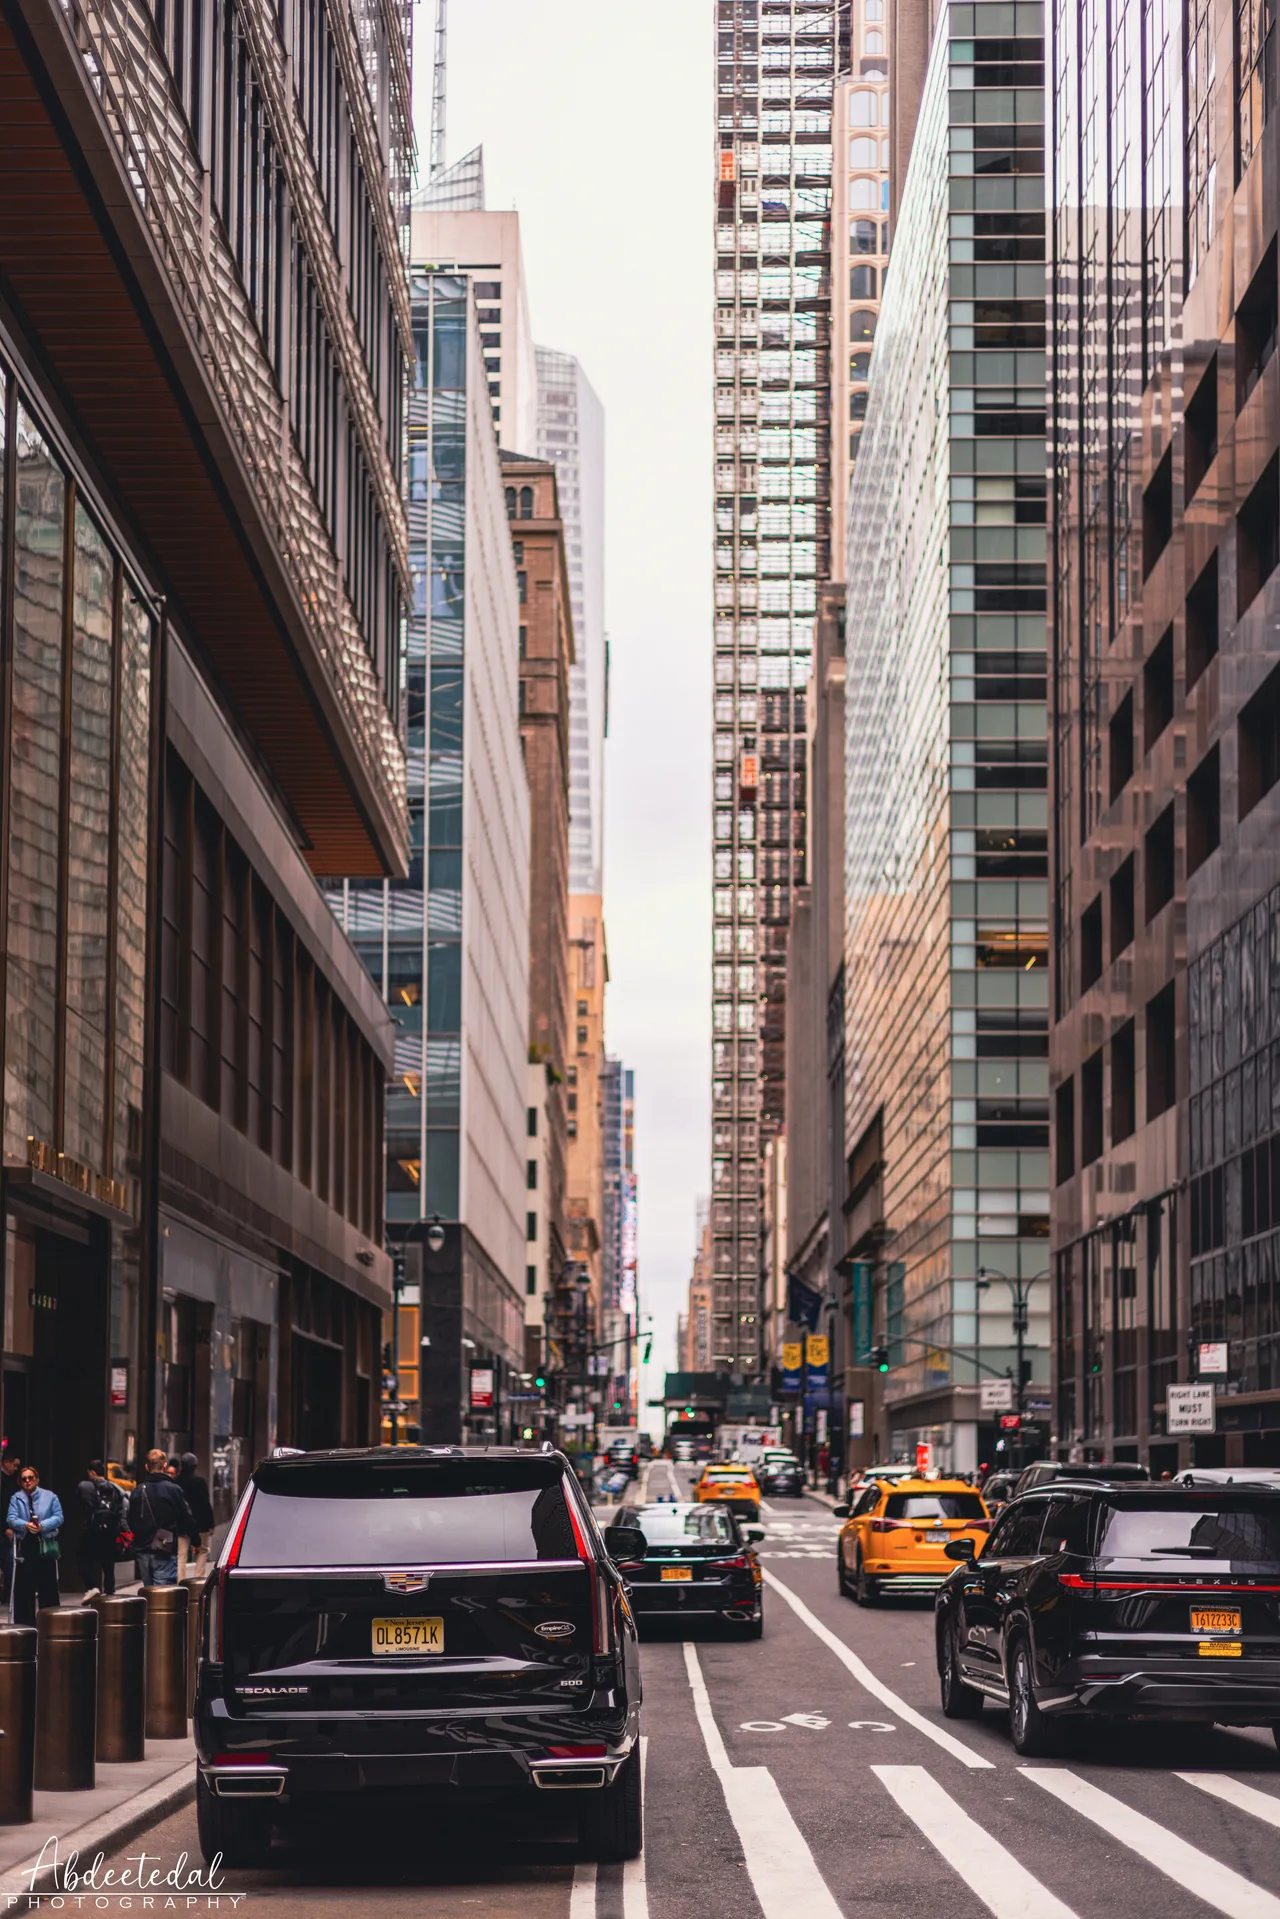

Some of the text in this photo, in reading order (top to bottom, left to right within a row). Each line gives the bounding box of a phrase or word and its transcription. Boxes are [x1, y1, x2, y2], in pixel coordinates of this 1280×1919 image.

[1179, 1403, 1203, 1413] MUST
[1171, 1418, 1189, 1426] TURN
[1191, 1417, 1212, 1426] RIGHT
[1178, 1578, 1256, 1586] LEXUS
[406, 1619, 426, 1627] Jersey
[1194, 1613, 1238, 1627] T612233C
